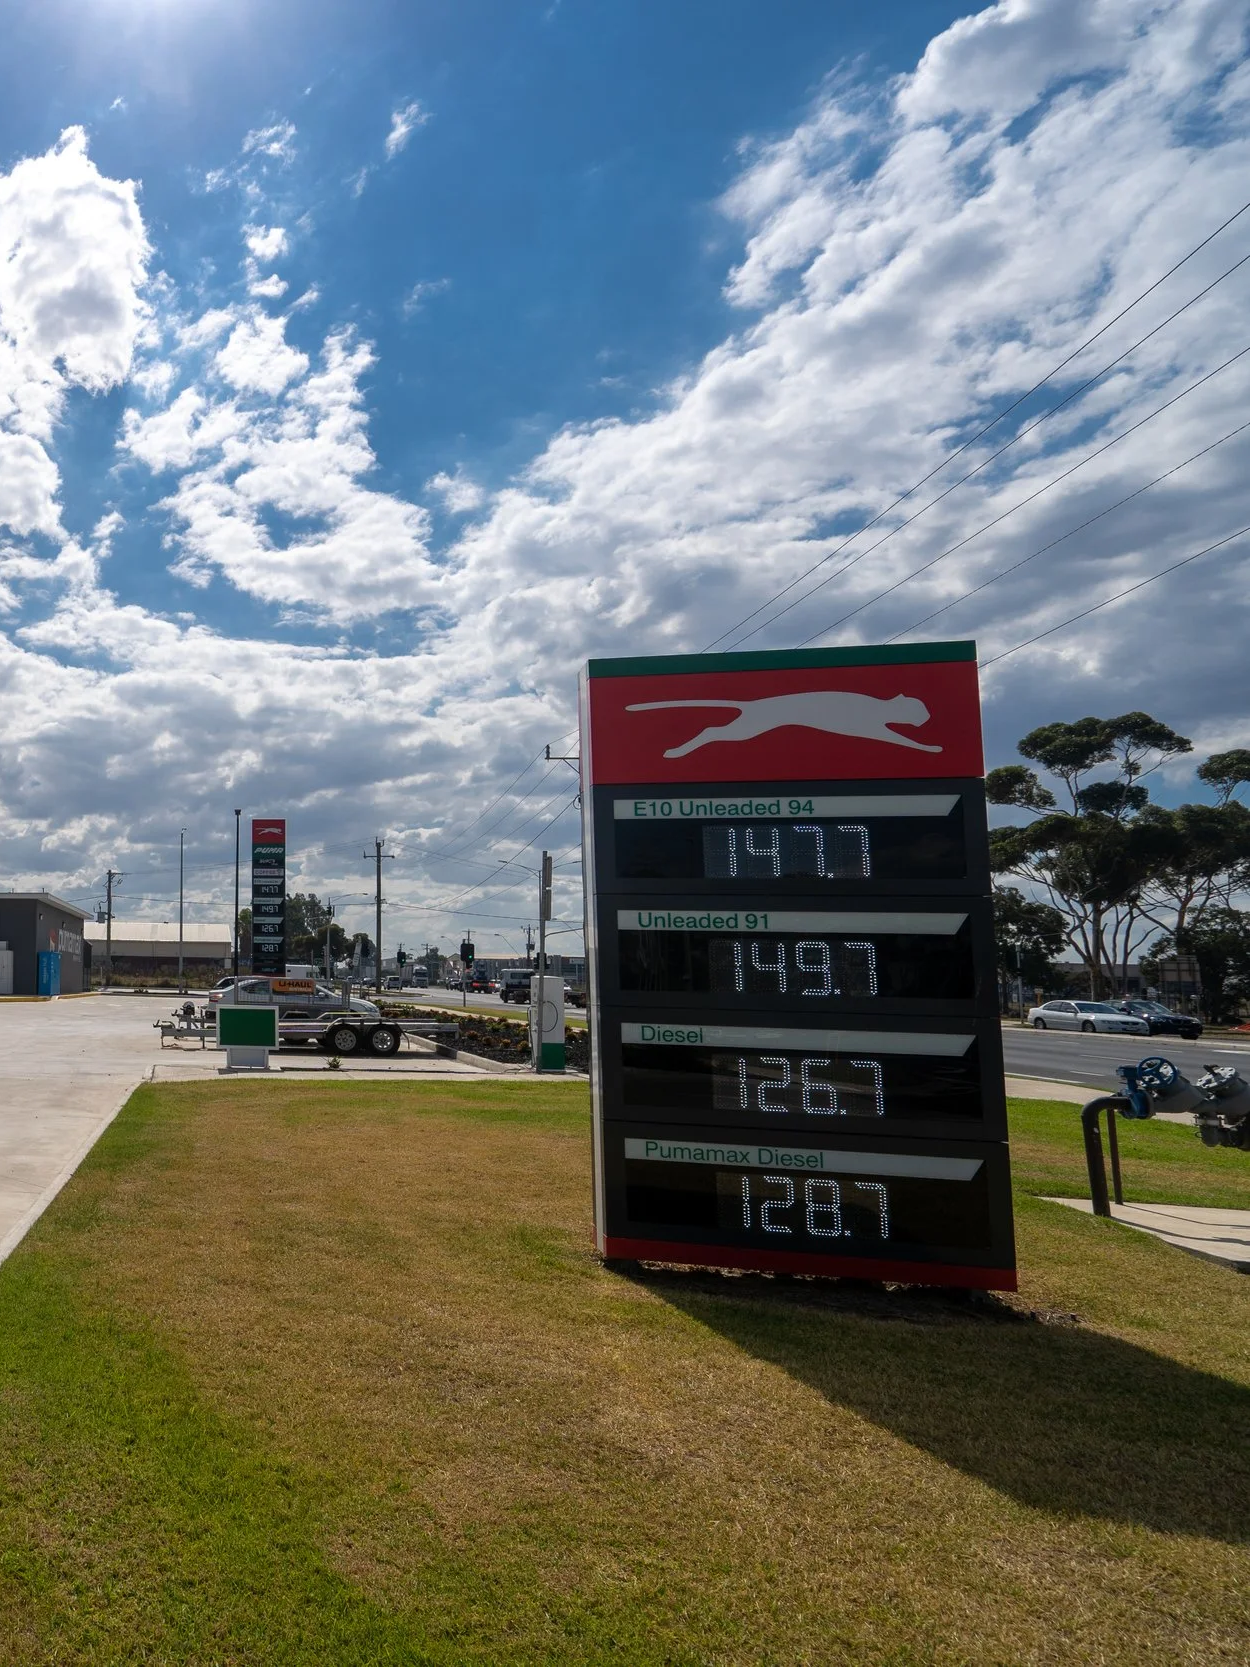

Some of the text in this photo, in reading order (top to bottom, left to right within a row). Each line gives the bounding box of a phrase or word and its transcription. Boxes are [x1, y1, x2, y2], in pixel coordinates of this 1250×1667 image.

[634, 800, 815, 817] E10 Unleaded 94
[728, 825, 870, 878] 147.7
[638, 912, 770, 930] Unleaded 91
[733, 941, 878, 996] 149.7
[641, 1025, 704, 1043] Diesel
[737, 1057, 885, 1116] 126.7
[645, 1141, 825, 1168] Pumamax Diesel
[741, 1176, 890, 1239] 128.7
